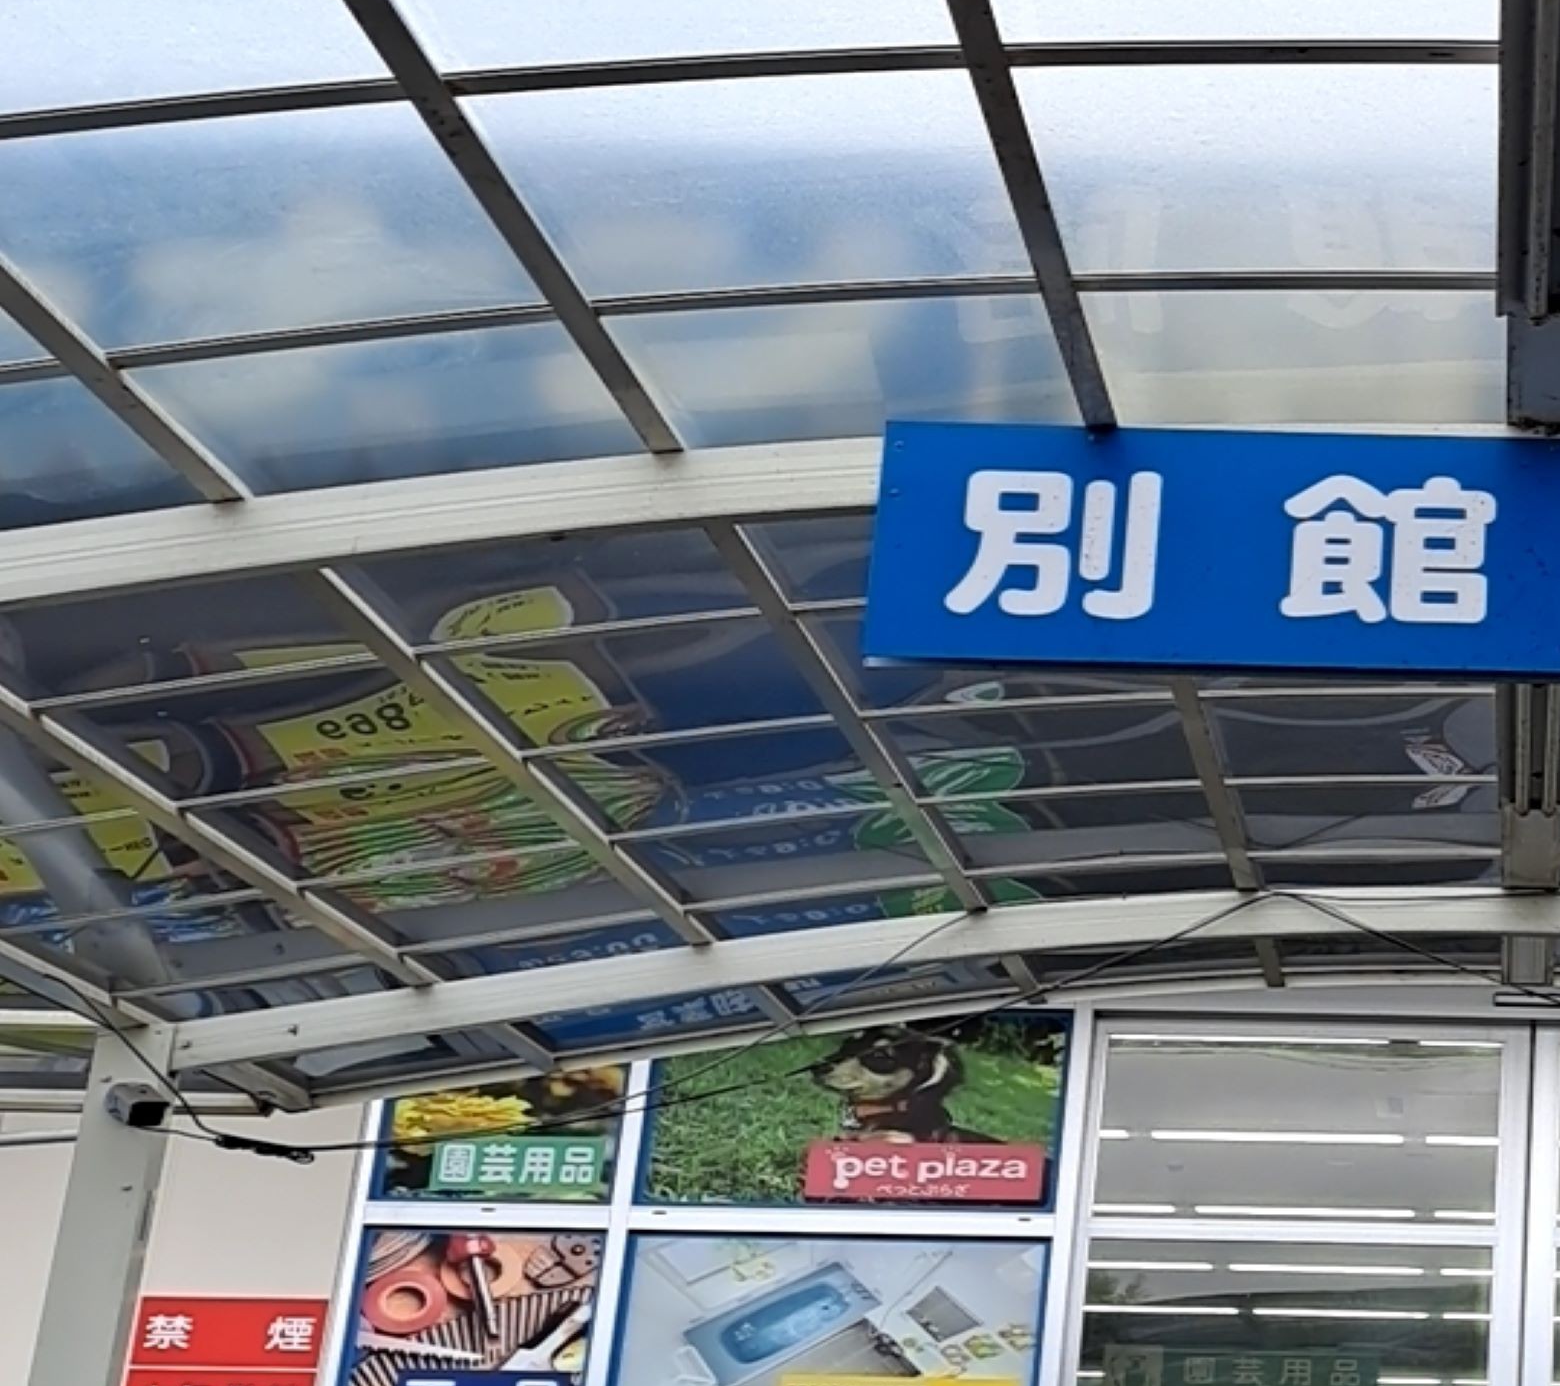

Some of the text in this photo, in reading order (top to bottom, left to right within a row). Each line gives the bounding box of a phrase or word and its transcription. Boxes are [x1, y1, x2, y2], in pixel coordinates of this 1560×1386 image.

[438, 1142, 596, 1185] 園芸用品
[833, 1152, 1028, 1189] pet plaza
[143, 1314, 316, 1352] 禁煙
